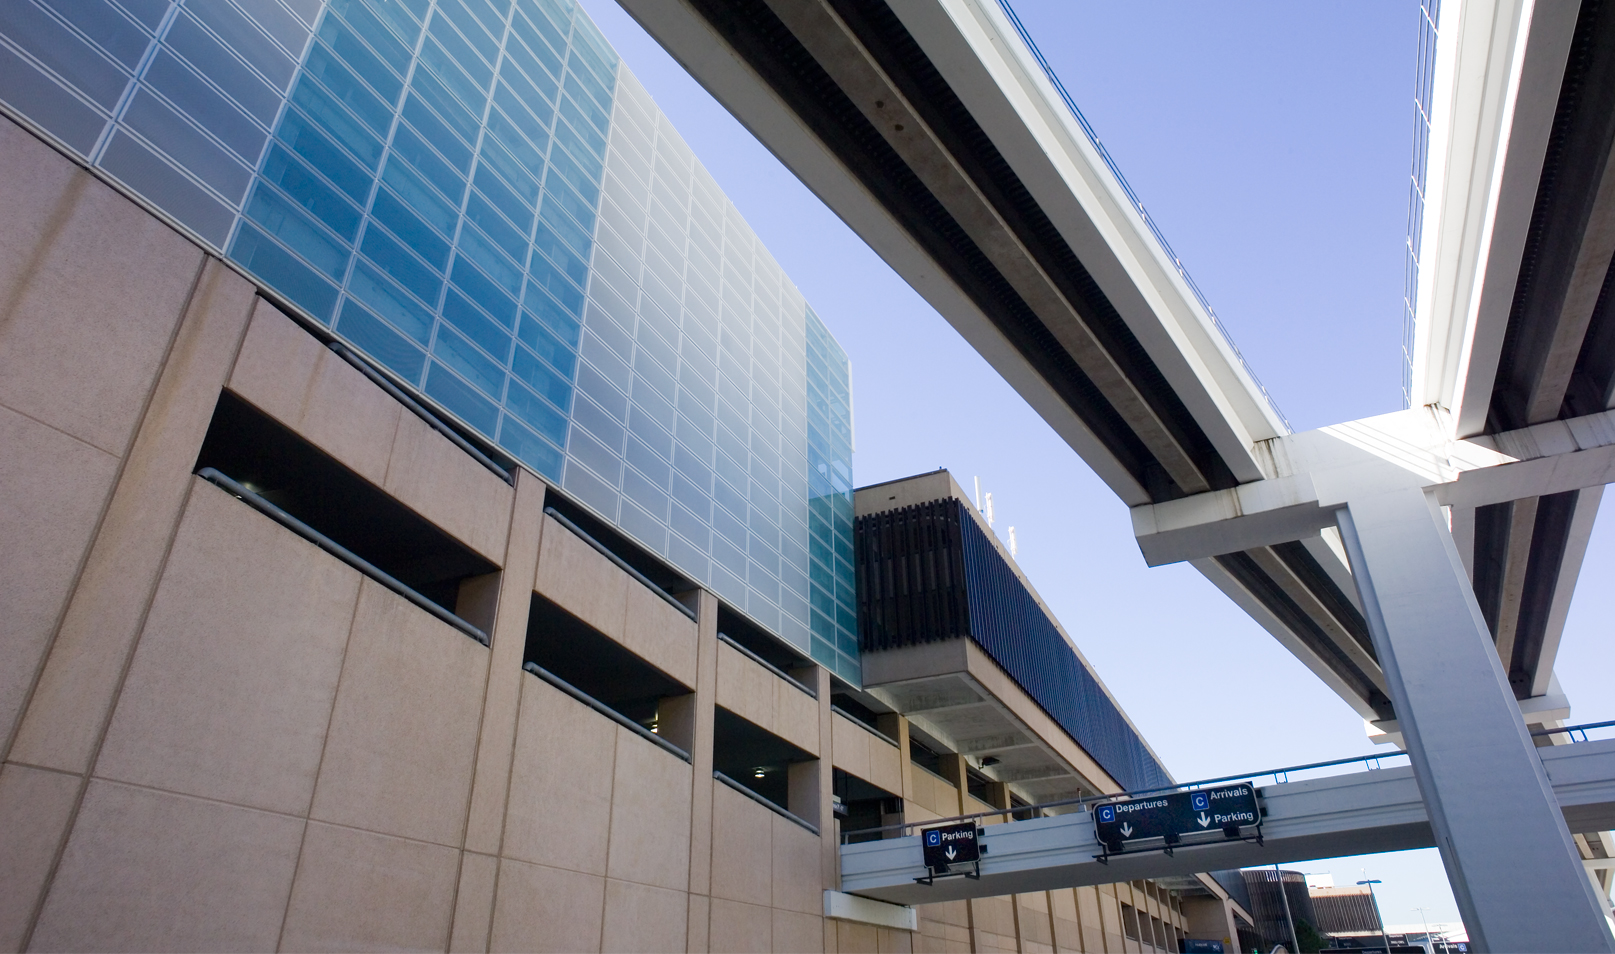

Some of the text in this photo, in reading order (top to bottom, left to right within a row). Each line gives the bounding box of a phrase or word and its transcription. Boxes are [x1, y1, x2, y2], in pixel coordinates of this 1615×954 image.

[1196, 787, 1248, 806] C Arrivals
[1102, 799, 1168, 818] C Departures
[1214, 811, 1254, 824] Parking
[930, 830, 973, 843] C Parking
